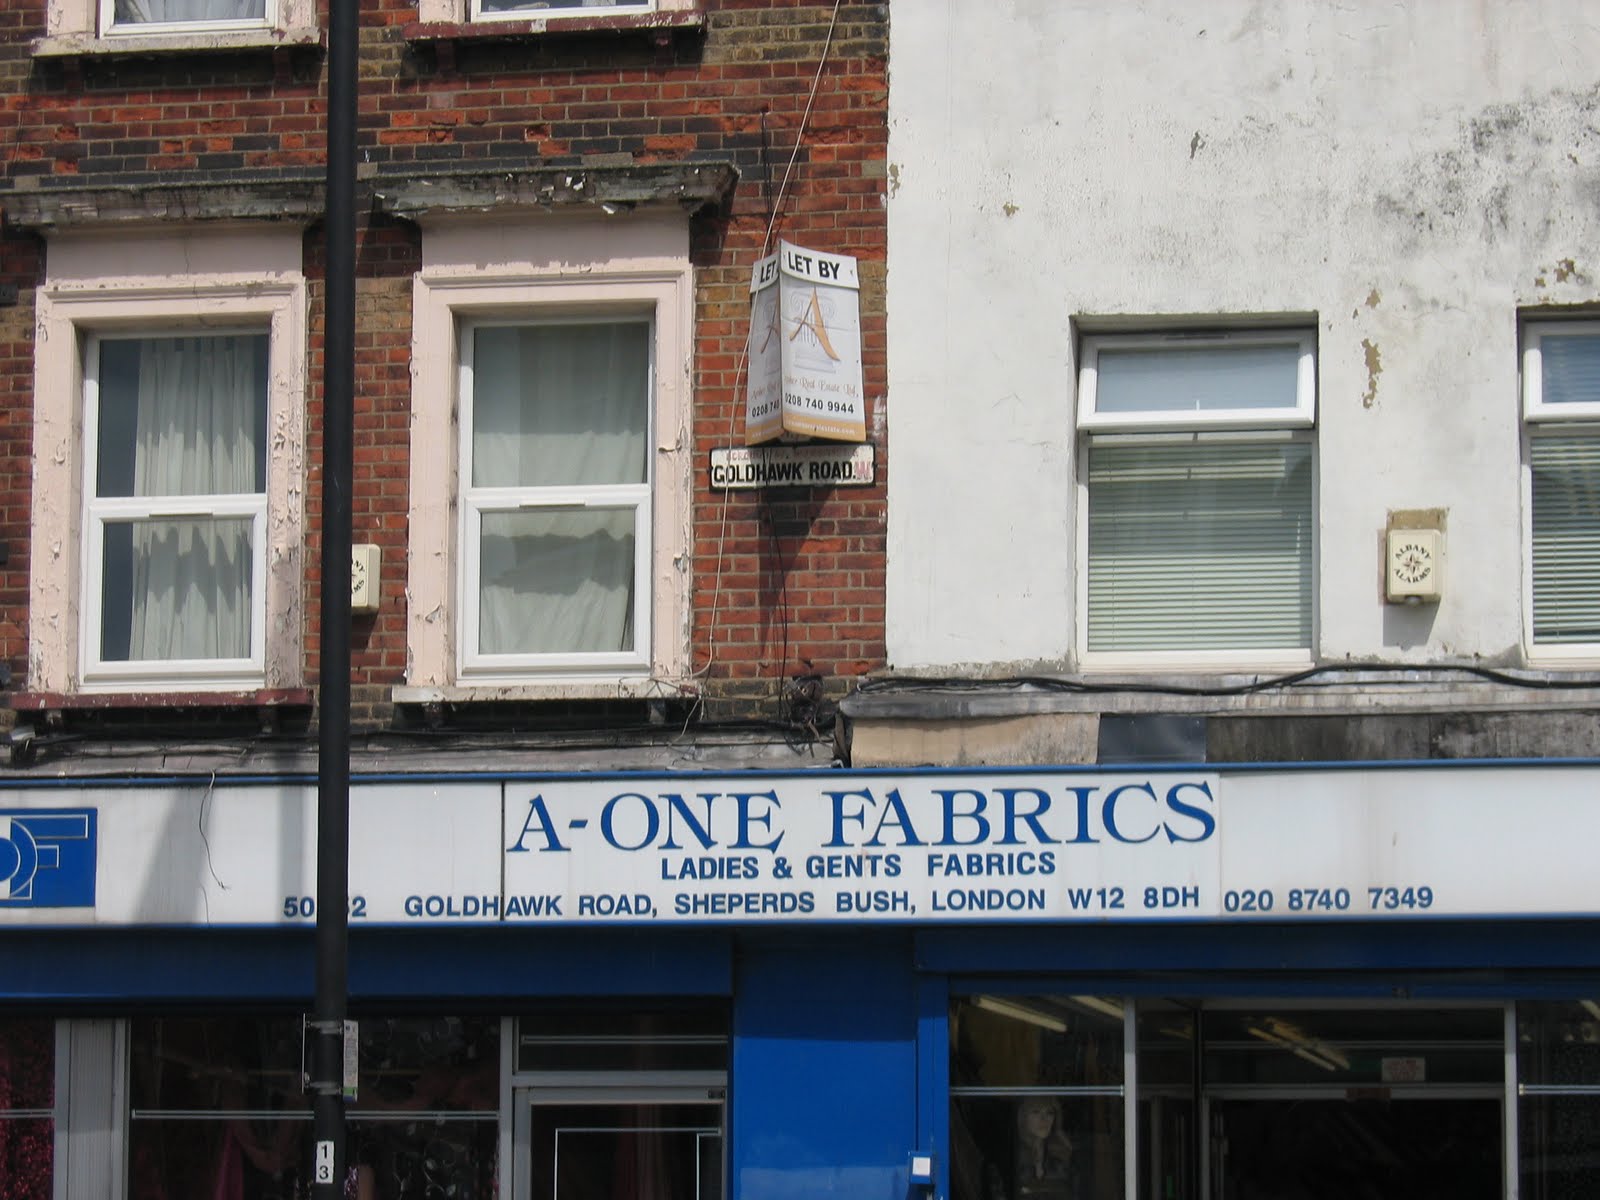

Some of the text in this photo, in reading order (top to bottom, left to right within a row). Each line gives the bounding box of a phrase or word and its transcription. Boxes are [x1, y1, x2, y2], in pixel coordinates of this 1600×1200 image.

[760, 260, 777, 282] LET
[788, 251, 840, 280] LET BY
[751, 403, 768, 418] 0208
[785, 393, 854, 414] 0208 740 9944
[713, 460, 802, 483] GOLDHAWK
[1394, 544, 1431, 561] ALBANY
[1394, 566, 1431, 584] ALARMS
[506, 781, 1216, 853] A-ONE FABRICS
[661, 851, 1056, 881] LADIES & GENTS FABRICS
[404, 894, 563, 918] GOLDHAWK
[578, 894, 658, 919] ROAD,
[674, 892, 815, 915] SHEPERDS
[836, 890, 916, 914] BUSH,
[932, 888, 1046, 912] LONDON
[1067, 887, 1125, 910] W12
[1143, 886, 1200, 909] 8DH
[1223, 886, 1434, 912] 020 8740 7349
